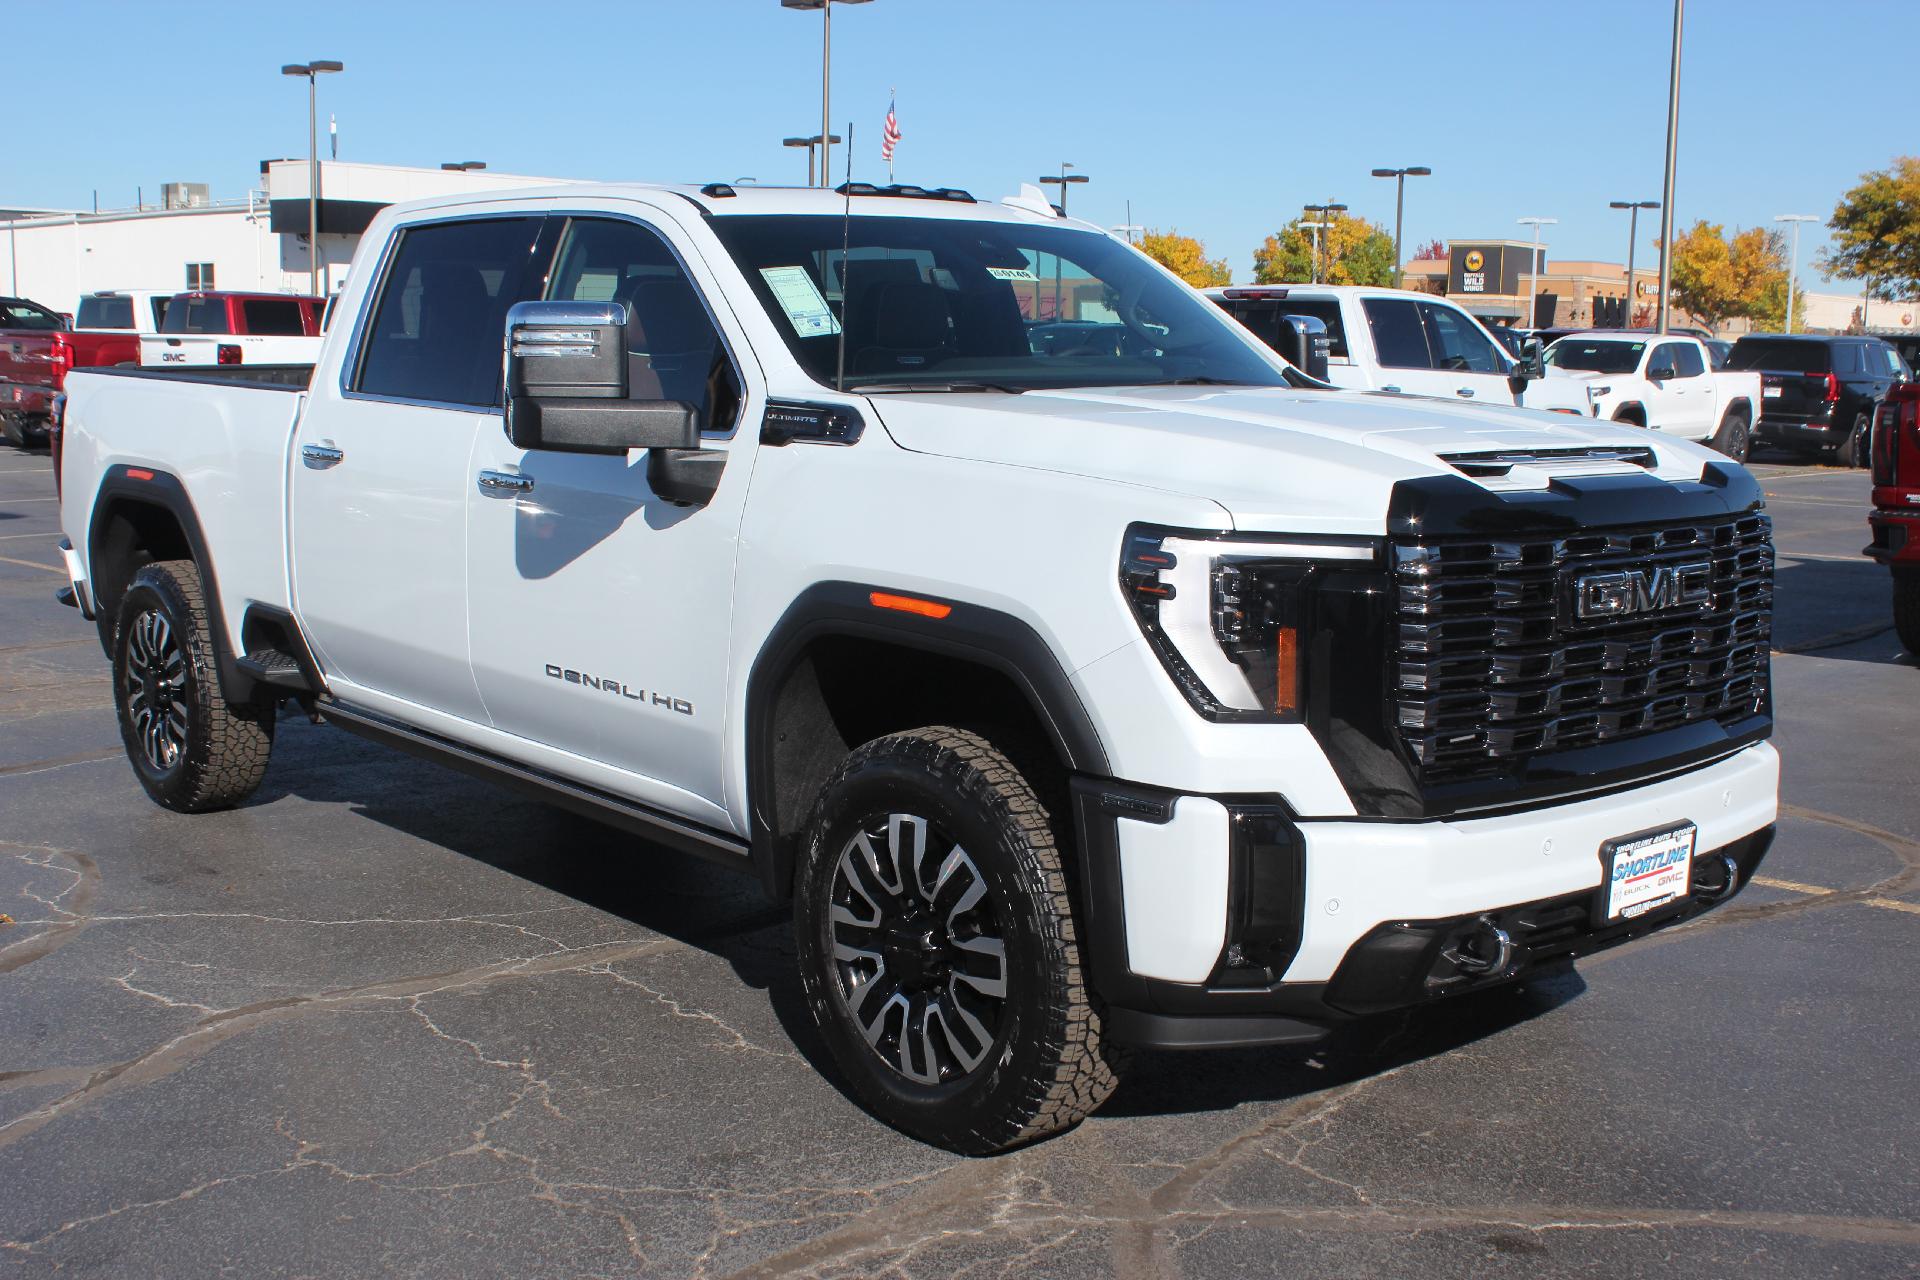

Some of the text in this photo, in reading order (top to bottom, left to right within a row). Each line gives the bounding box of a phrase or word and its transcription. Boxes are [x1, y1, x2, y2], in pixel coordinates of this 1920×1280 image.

[1463, 278, 1485, 286] WILD
[162, 353, 186, 362] GMC
[766, 413, 818, 423] ULTIMATE
[1577, 562, 1711, 618] GMC
[545, 663, 695, 716] DENALI HD
[1616, 838, 1653, 855] SHORTLINE
[1653, 833, 1672, 844] AUTO
[1612, 844, 1690, 882] SHORTLINE
[1623, 871, 1684, 896] BUICK GMC
